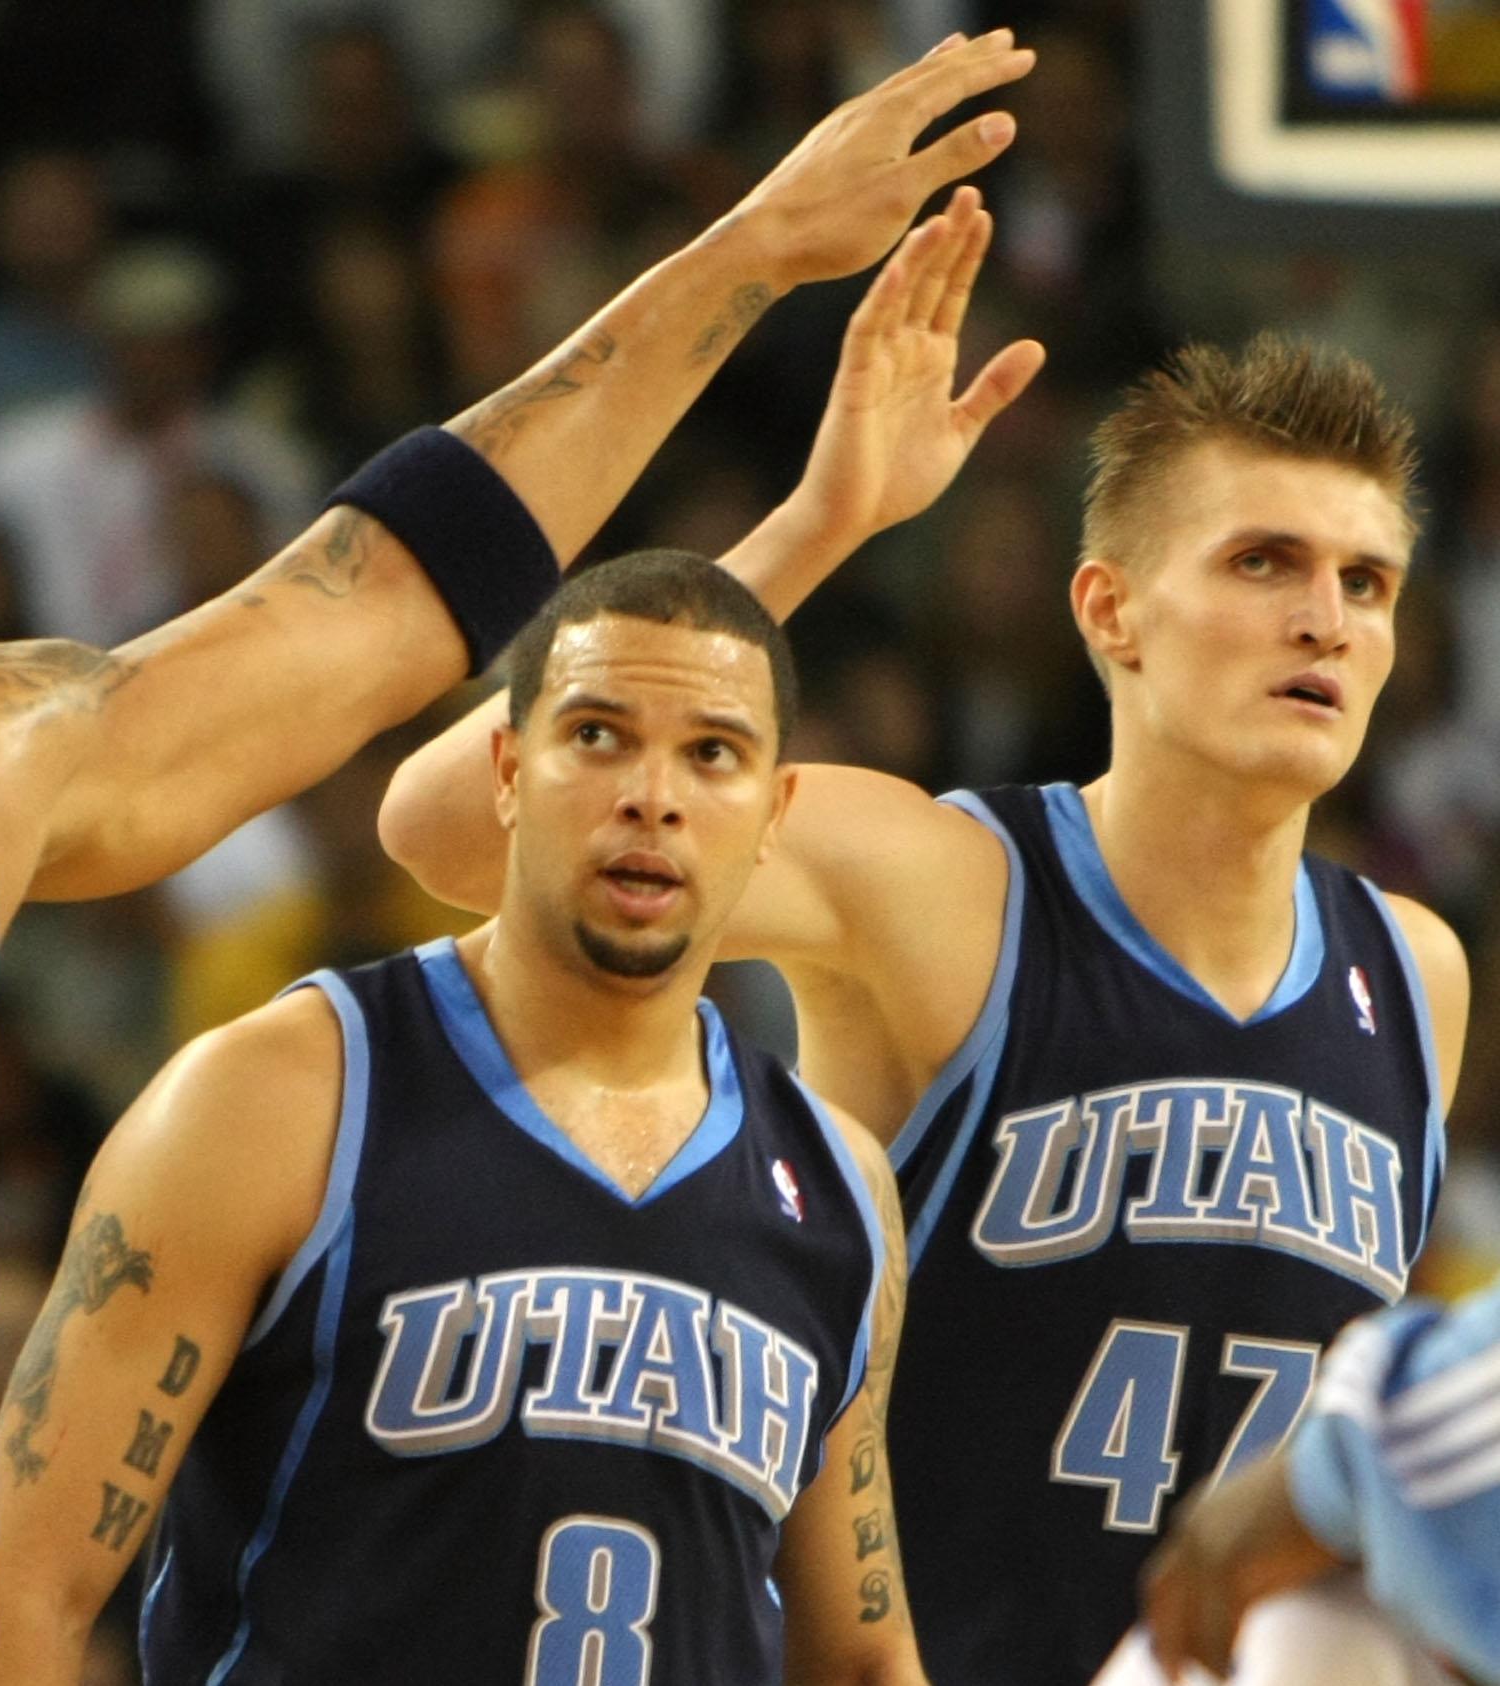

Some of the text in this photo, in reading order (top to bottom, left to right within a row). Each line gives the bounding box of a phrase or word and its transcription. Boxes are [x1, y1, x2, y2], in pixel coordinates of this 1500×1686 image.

[971, 1077, 1411, 1306] UTAH
[364, 1265, 821, 1524] UTAH
[1049, 1318, 1322, 1533] 47
[523, 1514, 662, 1686] 8
